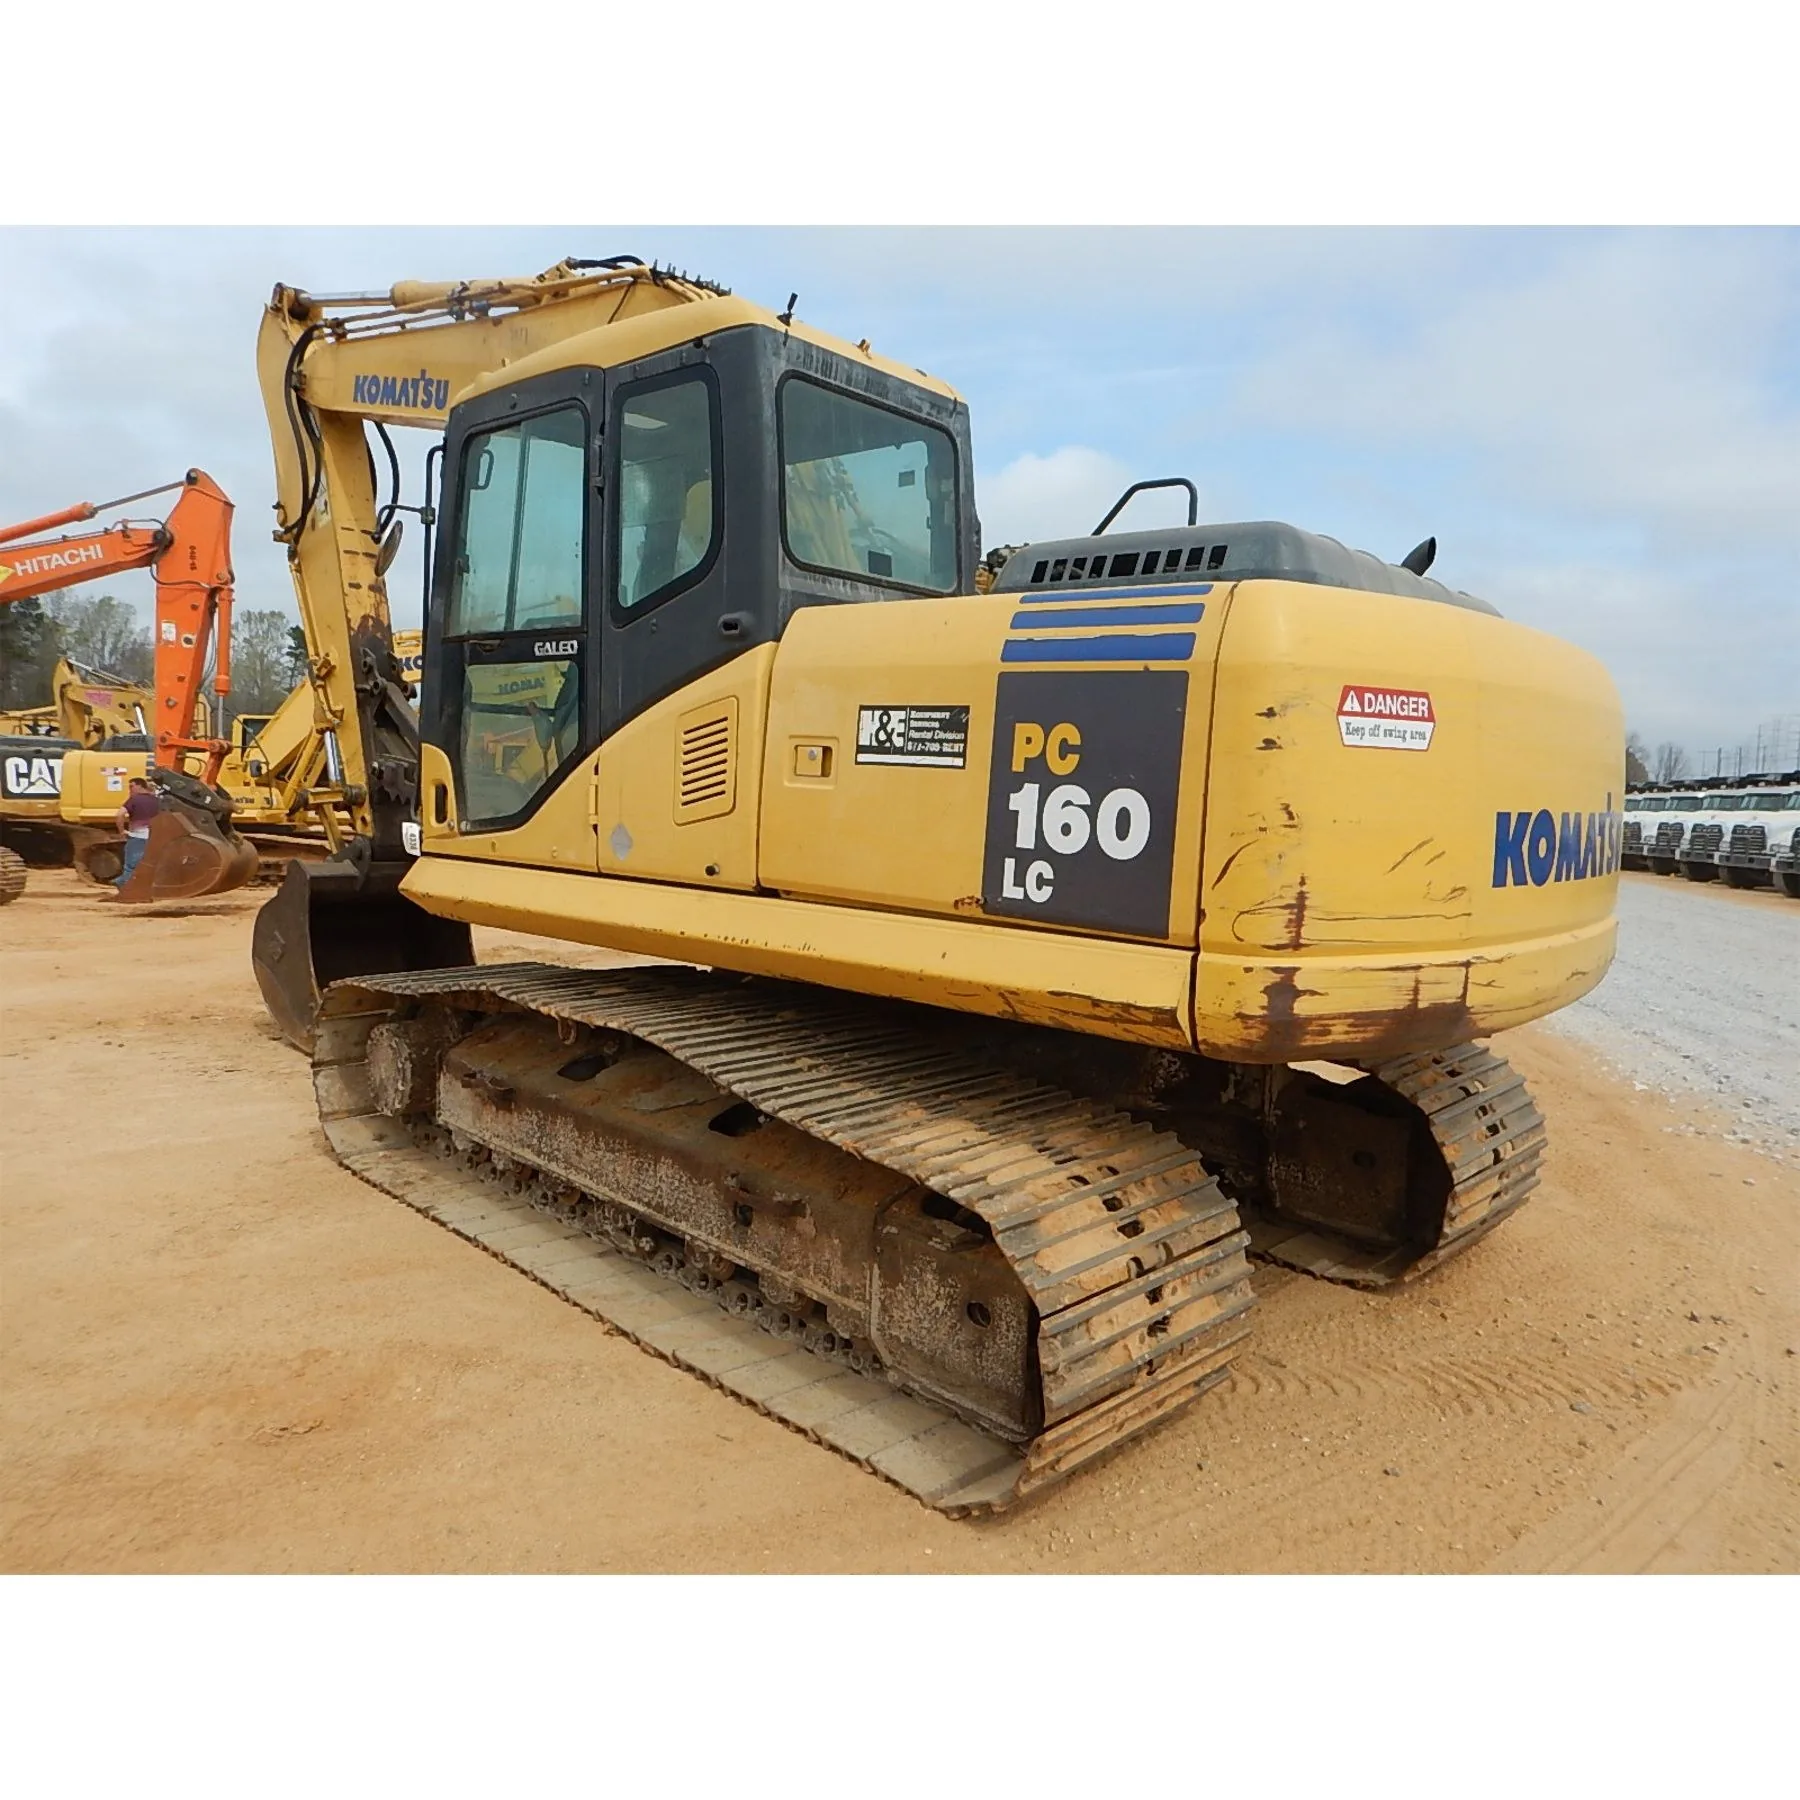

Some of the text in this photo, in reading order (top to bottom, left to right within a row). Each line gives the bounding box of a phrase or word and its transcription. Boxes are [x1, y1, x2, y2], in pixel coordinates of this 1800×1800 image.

[353, 369, 450, 410] KOMATSU
[15, 544, 104, 577] HITACHI
[1364, 692, 1429, 718] DANGER
[858, 710, 906, 748] H&E
[1345, 722, 1427, 743] Keep off swing area
[1012, 723, 1081, 776] PC
[5, 756, 64, 794] CAT
[1008, 782, 1151, 861] 160
[1002, 857, 1054, 903] LC
